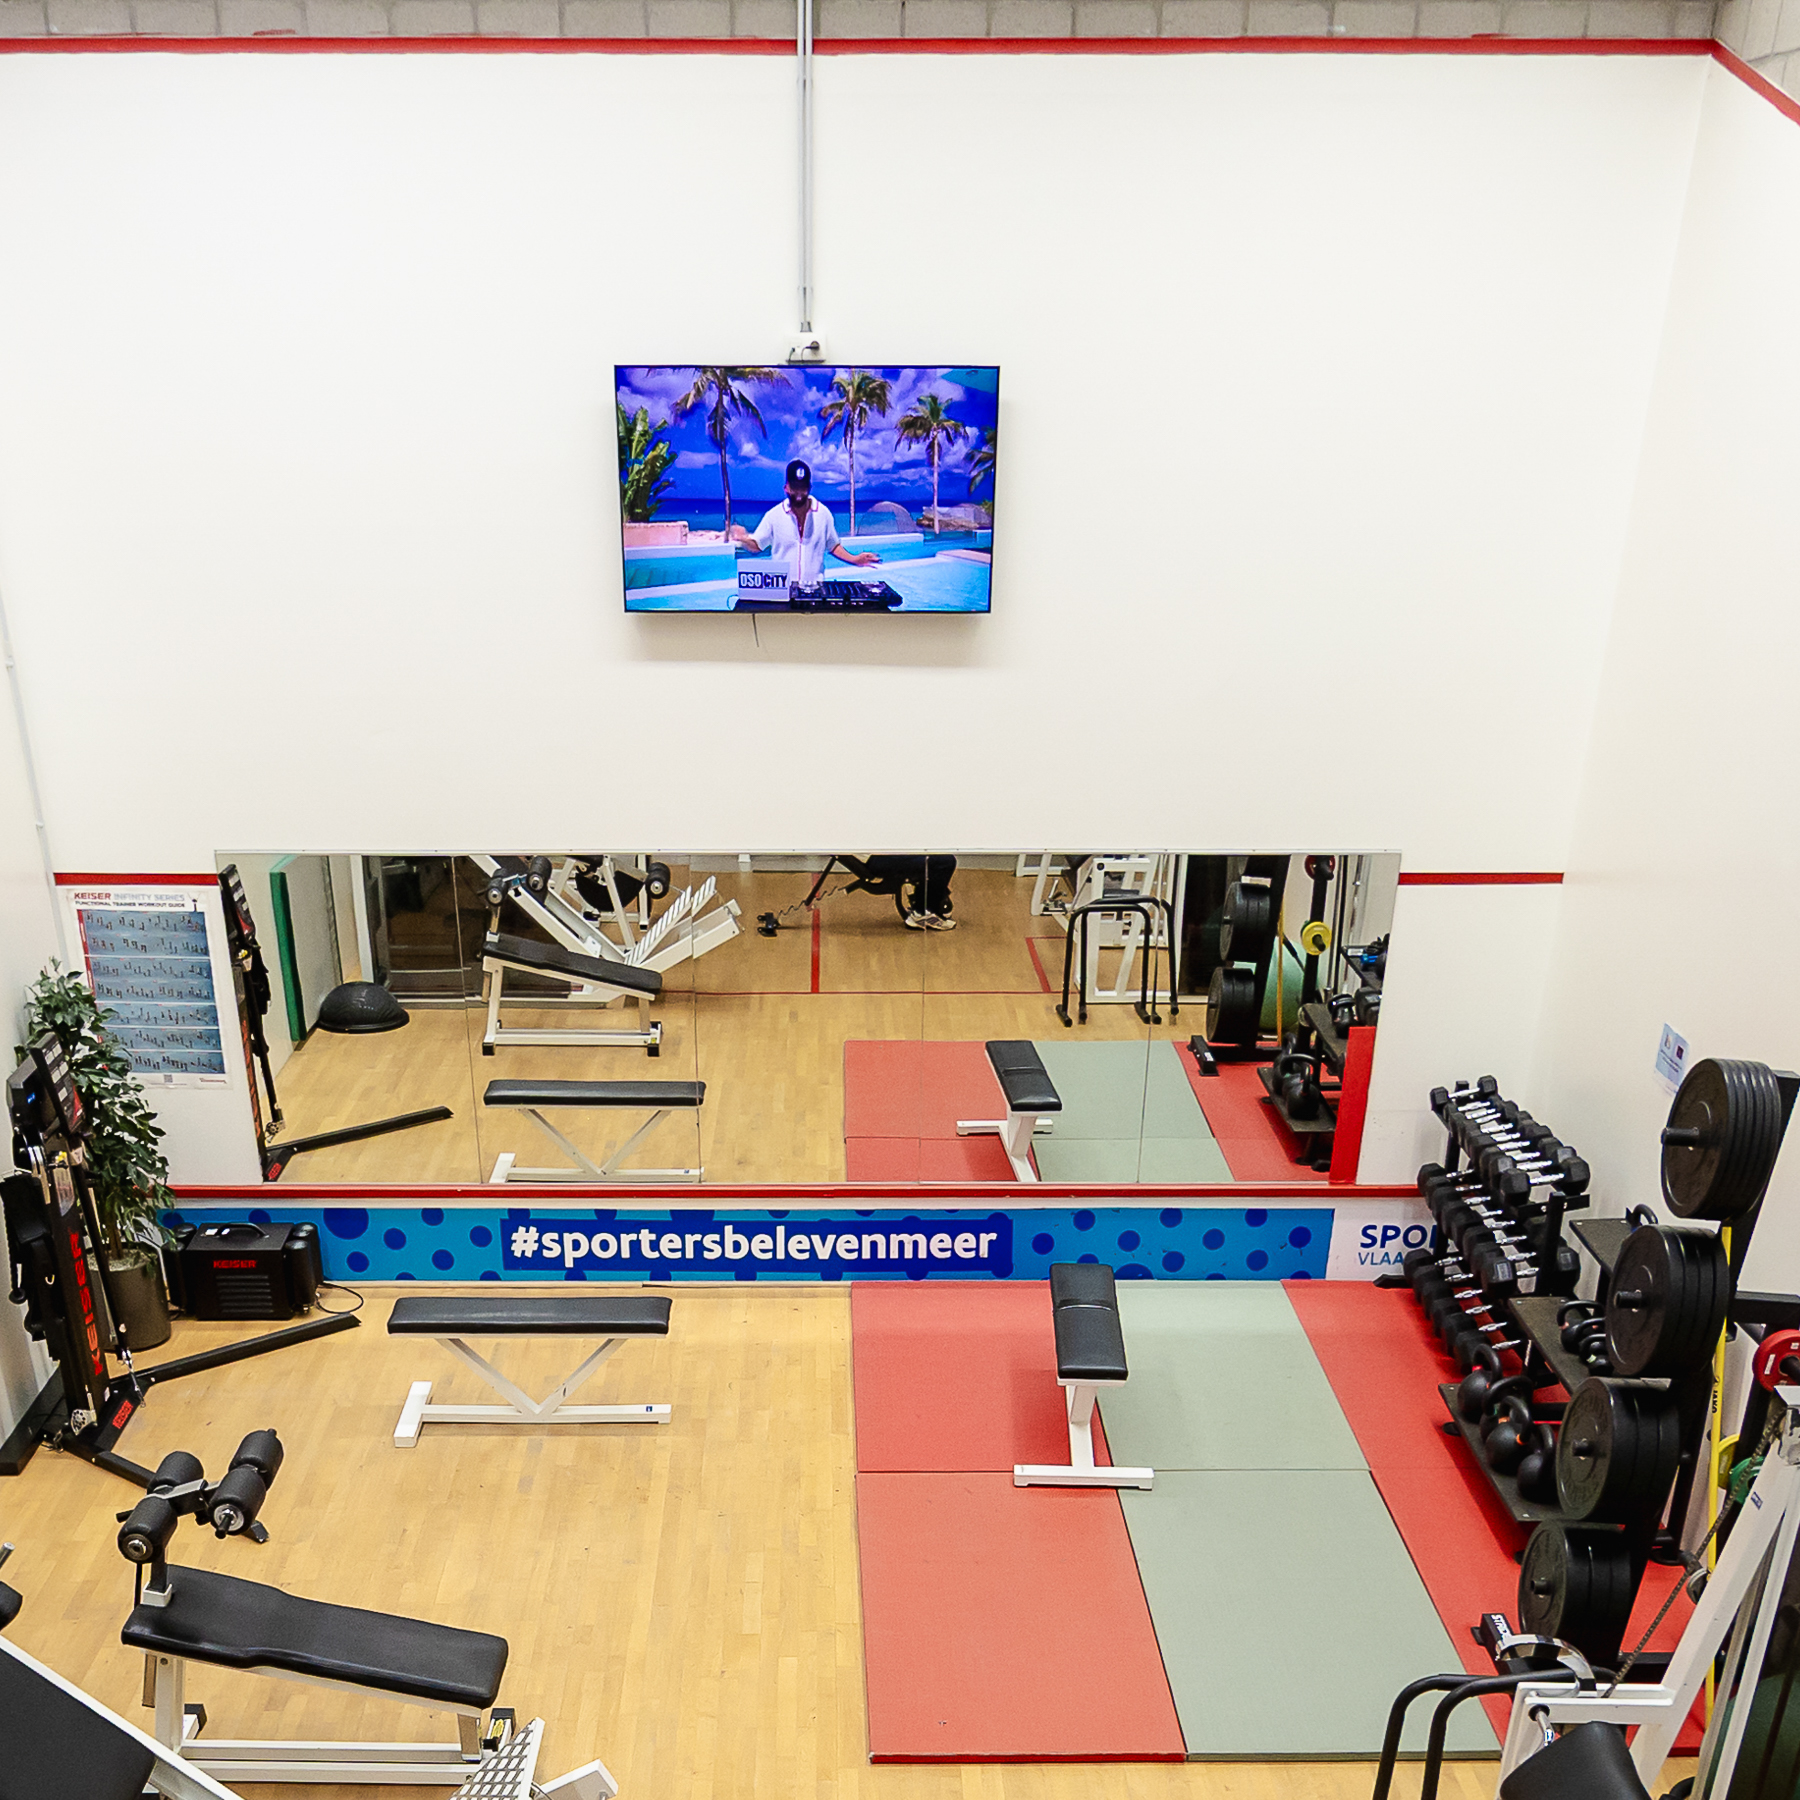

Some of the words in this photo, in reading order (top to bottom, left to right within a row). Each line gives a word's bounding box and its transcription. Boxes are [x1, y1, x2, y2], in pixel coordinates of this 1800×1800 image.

[740, 573, 762, 587] OSO
[74, 892, 111, 900] KEISER
[113, 893, 151, 901] INFINITY
[153, 894, 185, 902] SERIES
[510, 1225, 998, 1268] #sportersbelevenmeer
[213, 1260, 257, 1269] KEISER
[1358, 1252, 1405, 1266] VLAA
[70, 1231, 103, 1376] KEISER
